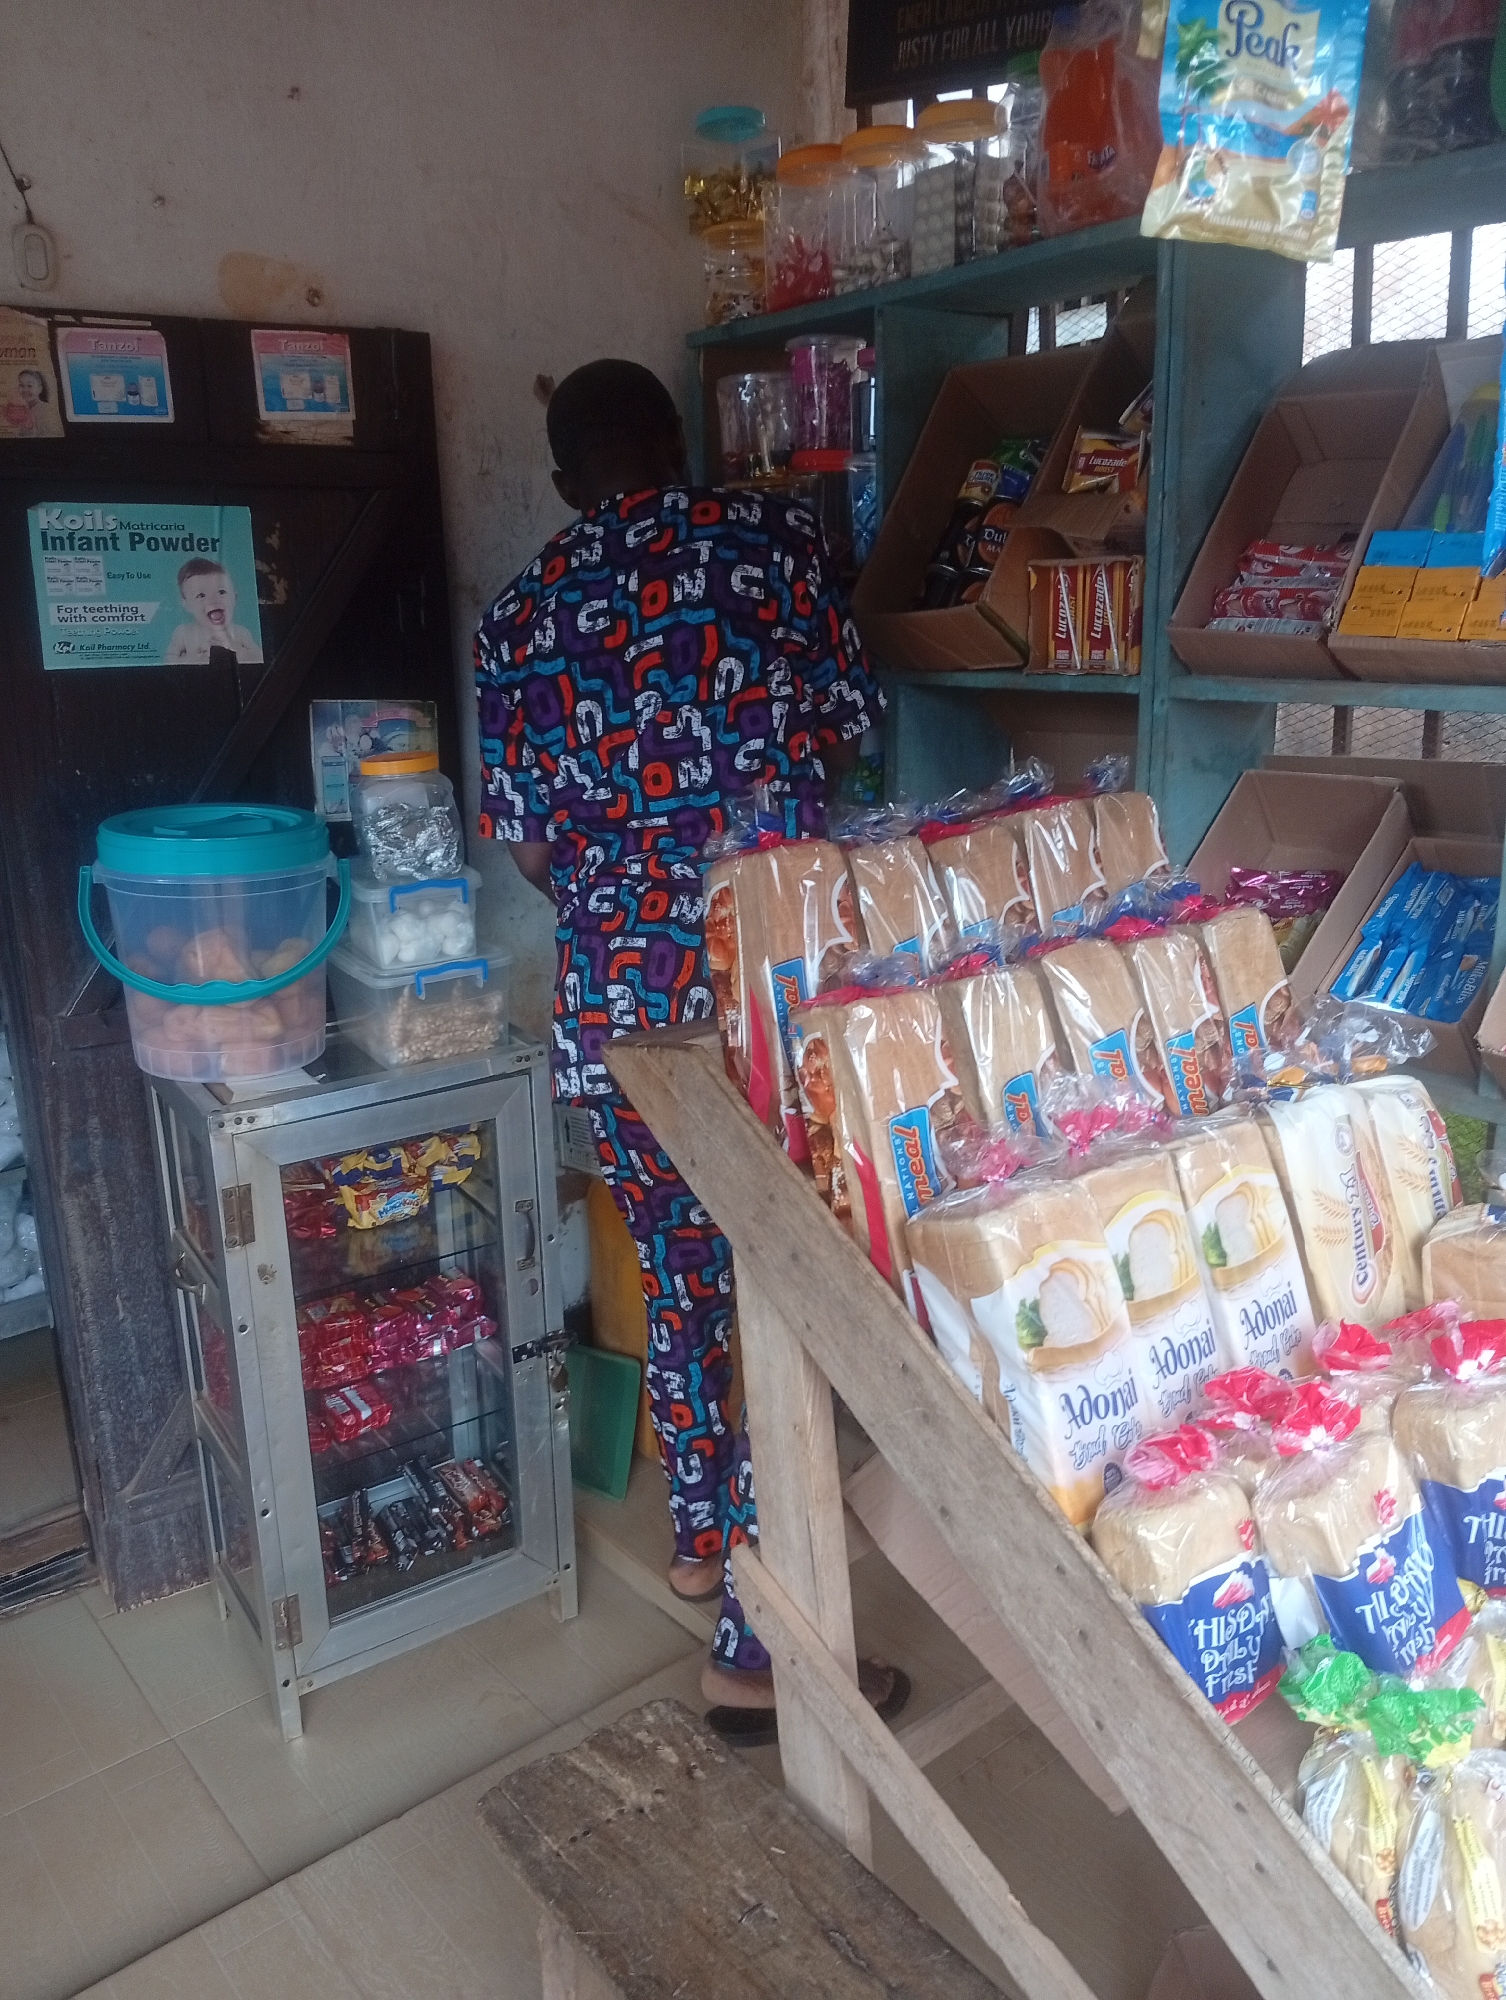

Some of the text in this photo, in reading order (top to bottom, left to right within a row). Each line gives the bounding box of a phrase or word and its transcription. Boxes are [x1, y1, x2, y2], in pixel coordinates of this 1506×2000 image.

[941, 25, 970, 62] FOR
[972, 19, 999, 56] ALL
[1225, 0, 1300, 71] Peak
[91, 338, 140, 353] Tanzol
[278, 339, 325, 352] Tanzol
[39, 508, 185, 532] Koils Matricaria
[41, 531, 221, 553] Infant Powder
[57, 603, 139, 616] For teething
[57, 612, 146, 624] with comfort
[1169, 1047, 1210, 1117] meal
[892, 1124, 935, 1204] meal
[893, 1137, 915, 1201] NATIONS
[1350, 1206, 1369, 1286] Century
[1240, 1280, 1298, 1350] Adonai
[1149, 1317, 1217, 1390] Adonai
[1059, 1367, 1139, 1440] Adonai
